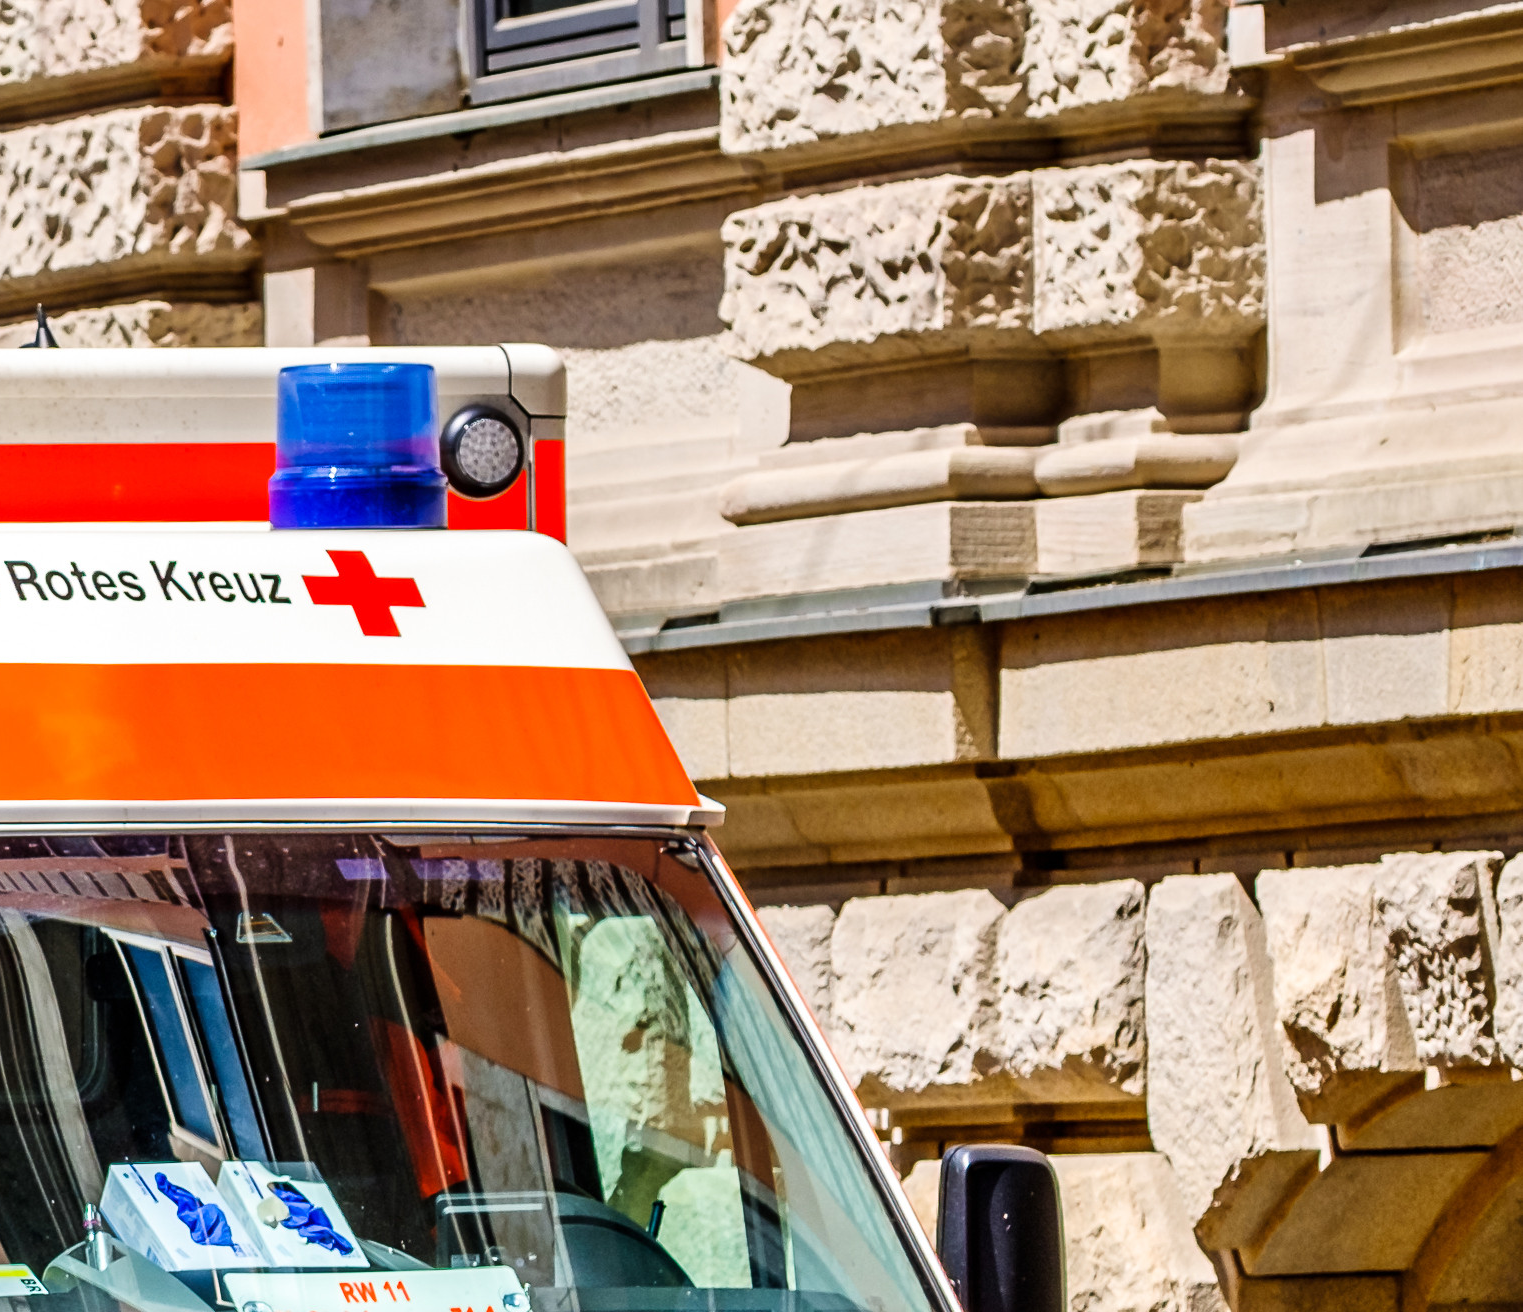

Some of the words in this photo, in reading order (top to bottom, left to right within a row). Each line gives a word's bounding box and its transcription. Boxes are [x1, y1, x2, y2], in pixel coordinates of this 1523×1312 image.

[3, 560, 147, 602] Rotes
[149, 560, 293, 604] Kreuz
[339, 1281, 378, 1304] RW
[383, 1280, 411, 1302] 11
